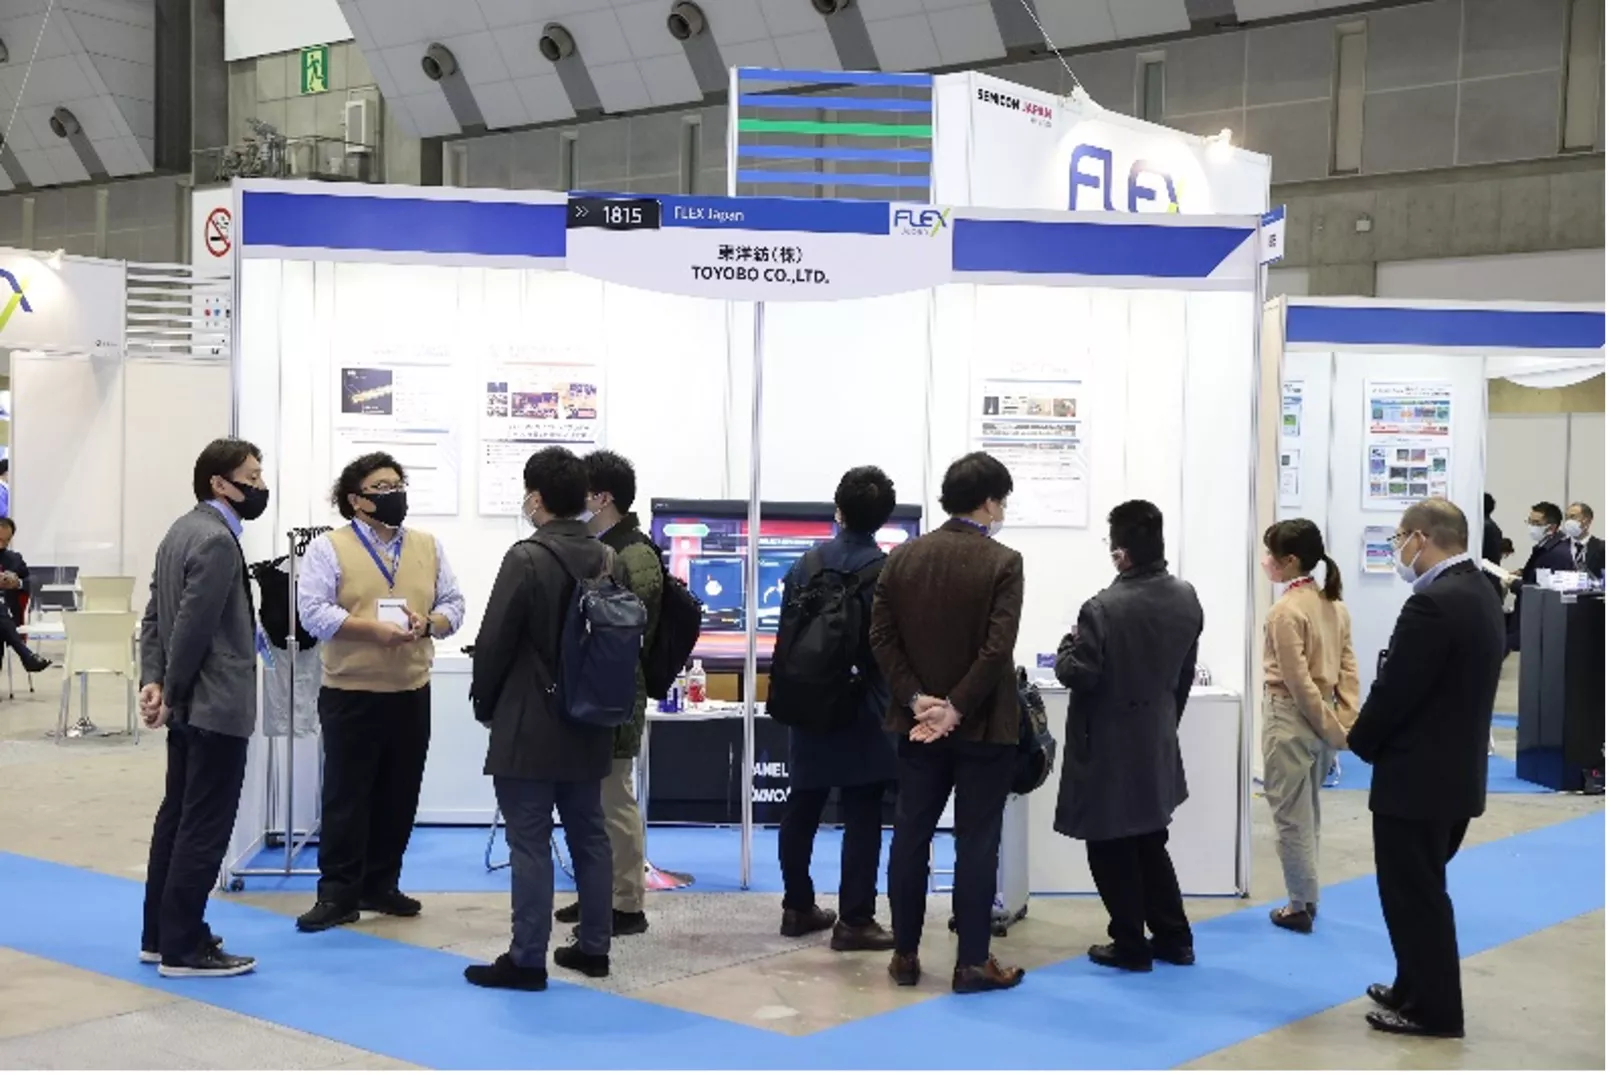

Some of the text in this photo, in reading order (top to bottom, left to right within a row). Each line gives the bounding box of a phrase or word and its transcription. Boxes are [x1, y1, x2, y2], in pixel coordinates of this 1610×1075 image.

[977, 88, 1020, 110] SEMICON
[603, 205, 643, 224] 1815
[674, 206, 745, 223] FLEX Japan
[893, 207, 951, 237] FLEX
[691, 265, 831, 285] TOYOBO CO.,LTD.
